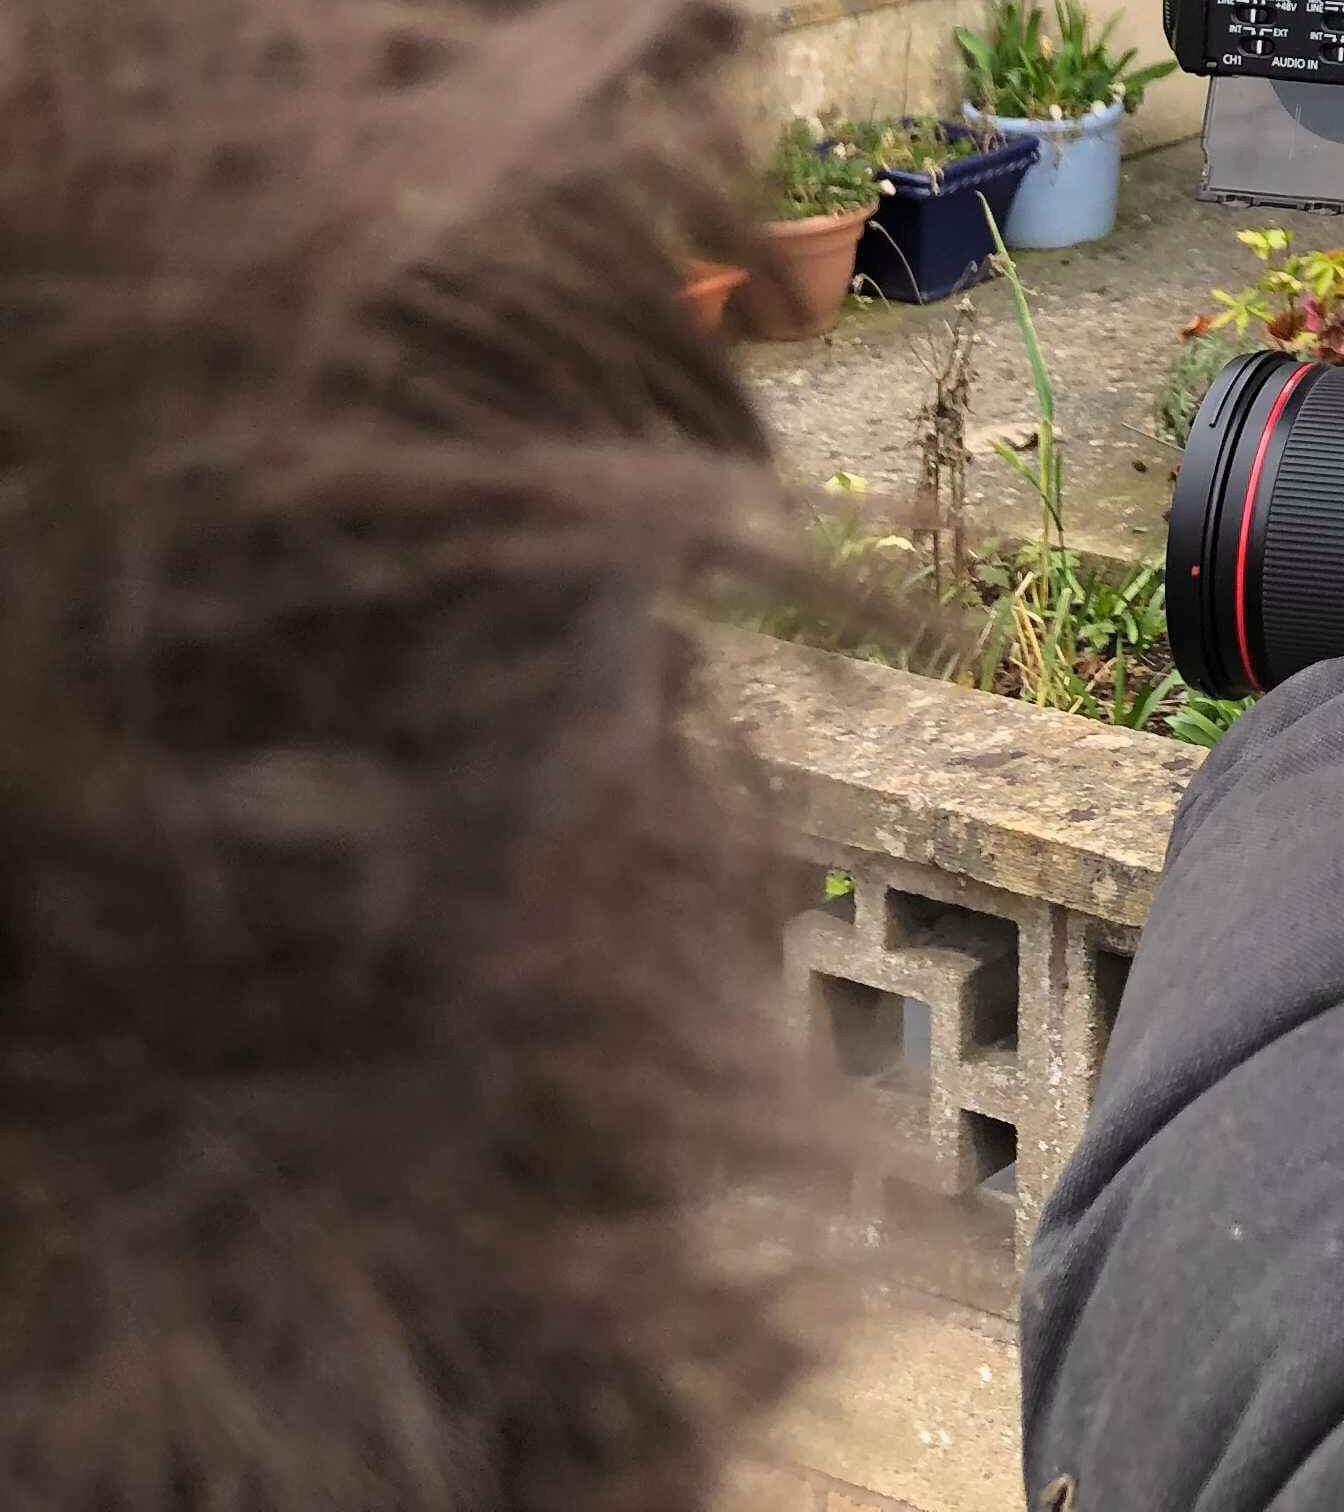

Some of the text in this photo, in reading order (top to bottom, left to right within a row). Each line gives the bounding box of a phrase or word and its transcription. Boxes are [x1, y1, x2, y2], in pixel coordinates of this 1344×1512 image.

[1306, 3, 1324, 13] LINE
[1229, 25, 1288, 37] INT EXT
[1310, 32, 1323, 41] INT
[1222, 54, 1242, 65] CH1
[1271, 57, 1319, 70] AUDIO IN
